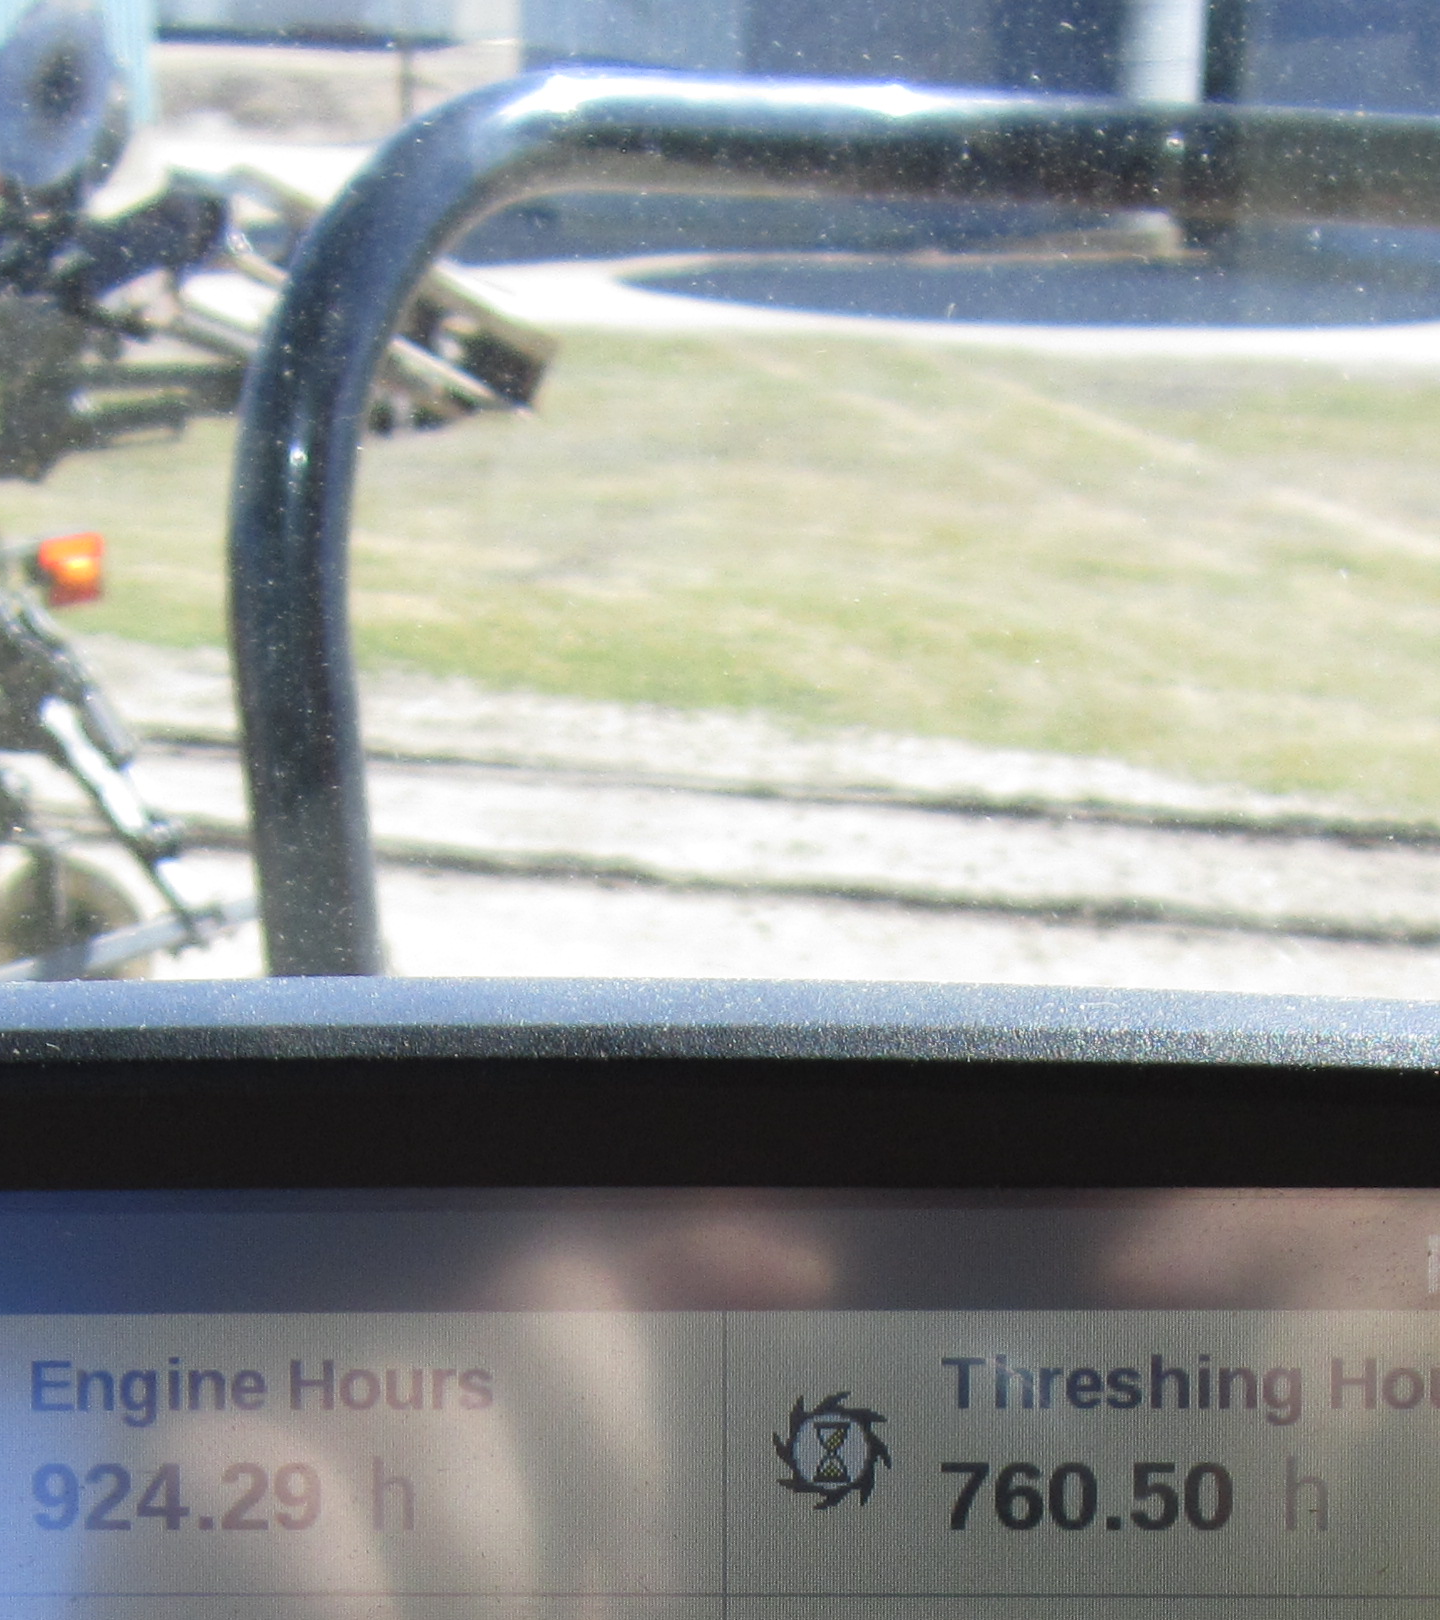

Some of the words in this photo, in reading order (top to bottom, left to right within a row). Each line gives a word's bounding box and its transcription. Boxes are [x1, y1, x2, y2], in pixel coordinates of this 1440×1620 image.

[31, 1357, 267, 1427] Engine
[289, 1360, 494, 1412] Hours
[941, 1355, 1304, 1425] Threshing
[32, 1462, 322, 1532] 924.29
[373, 1456, 416, 1532] h
[941, 1462, 1233, 1532] 760.50
[1284, 1457, 1330, 1532] h
